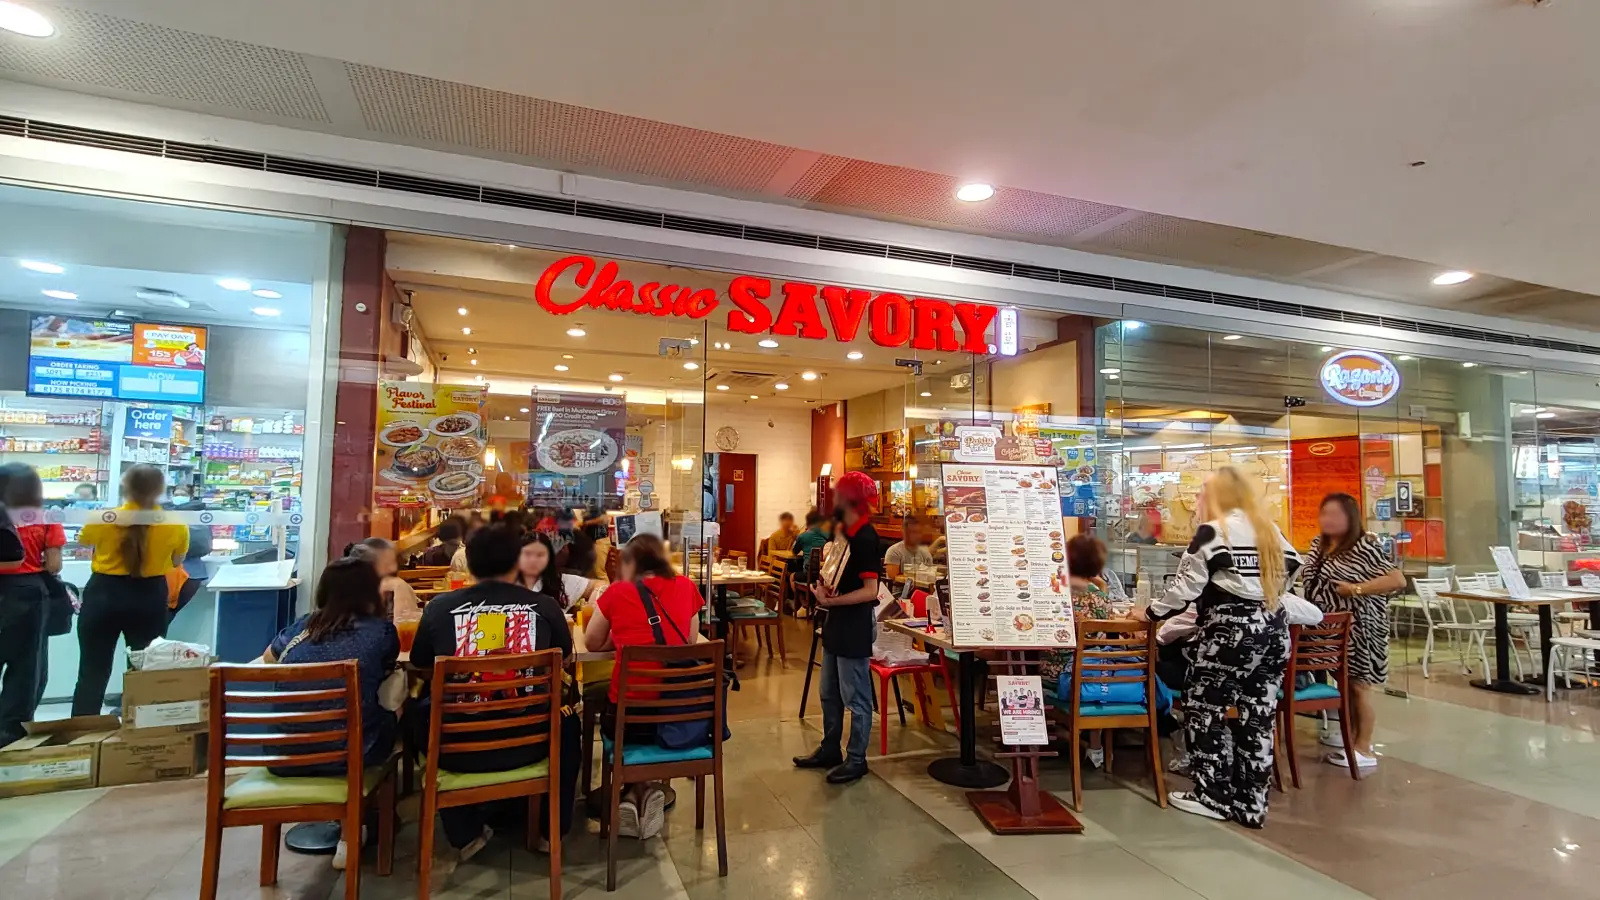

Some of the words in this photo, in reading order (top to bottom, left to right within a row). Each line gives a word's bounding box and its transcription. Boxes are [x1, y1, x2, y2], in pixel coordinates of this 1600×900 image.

[535, 255, 720, 319] Classic
[727, 275, 998, 355] SAVORY
[386, 387, 425, 400] Flavor
[392, 398, 437, 409] Festival
[131, 410, 168, 421] Order
[134, 419, 161, 431] here
[575, 452, 596, 460] FREE
[575, 460, 596, 468] DISH
